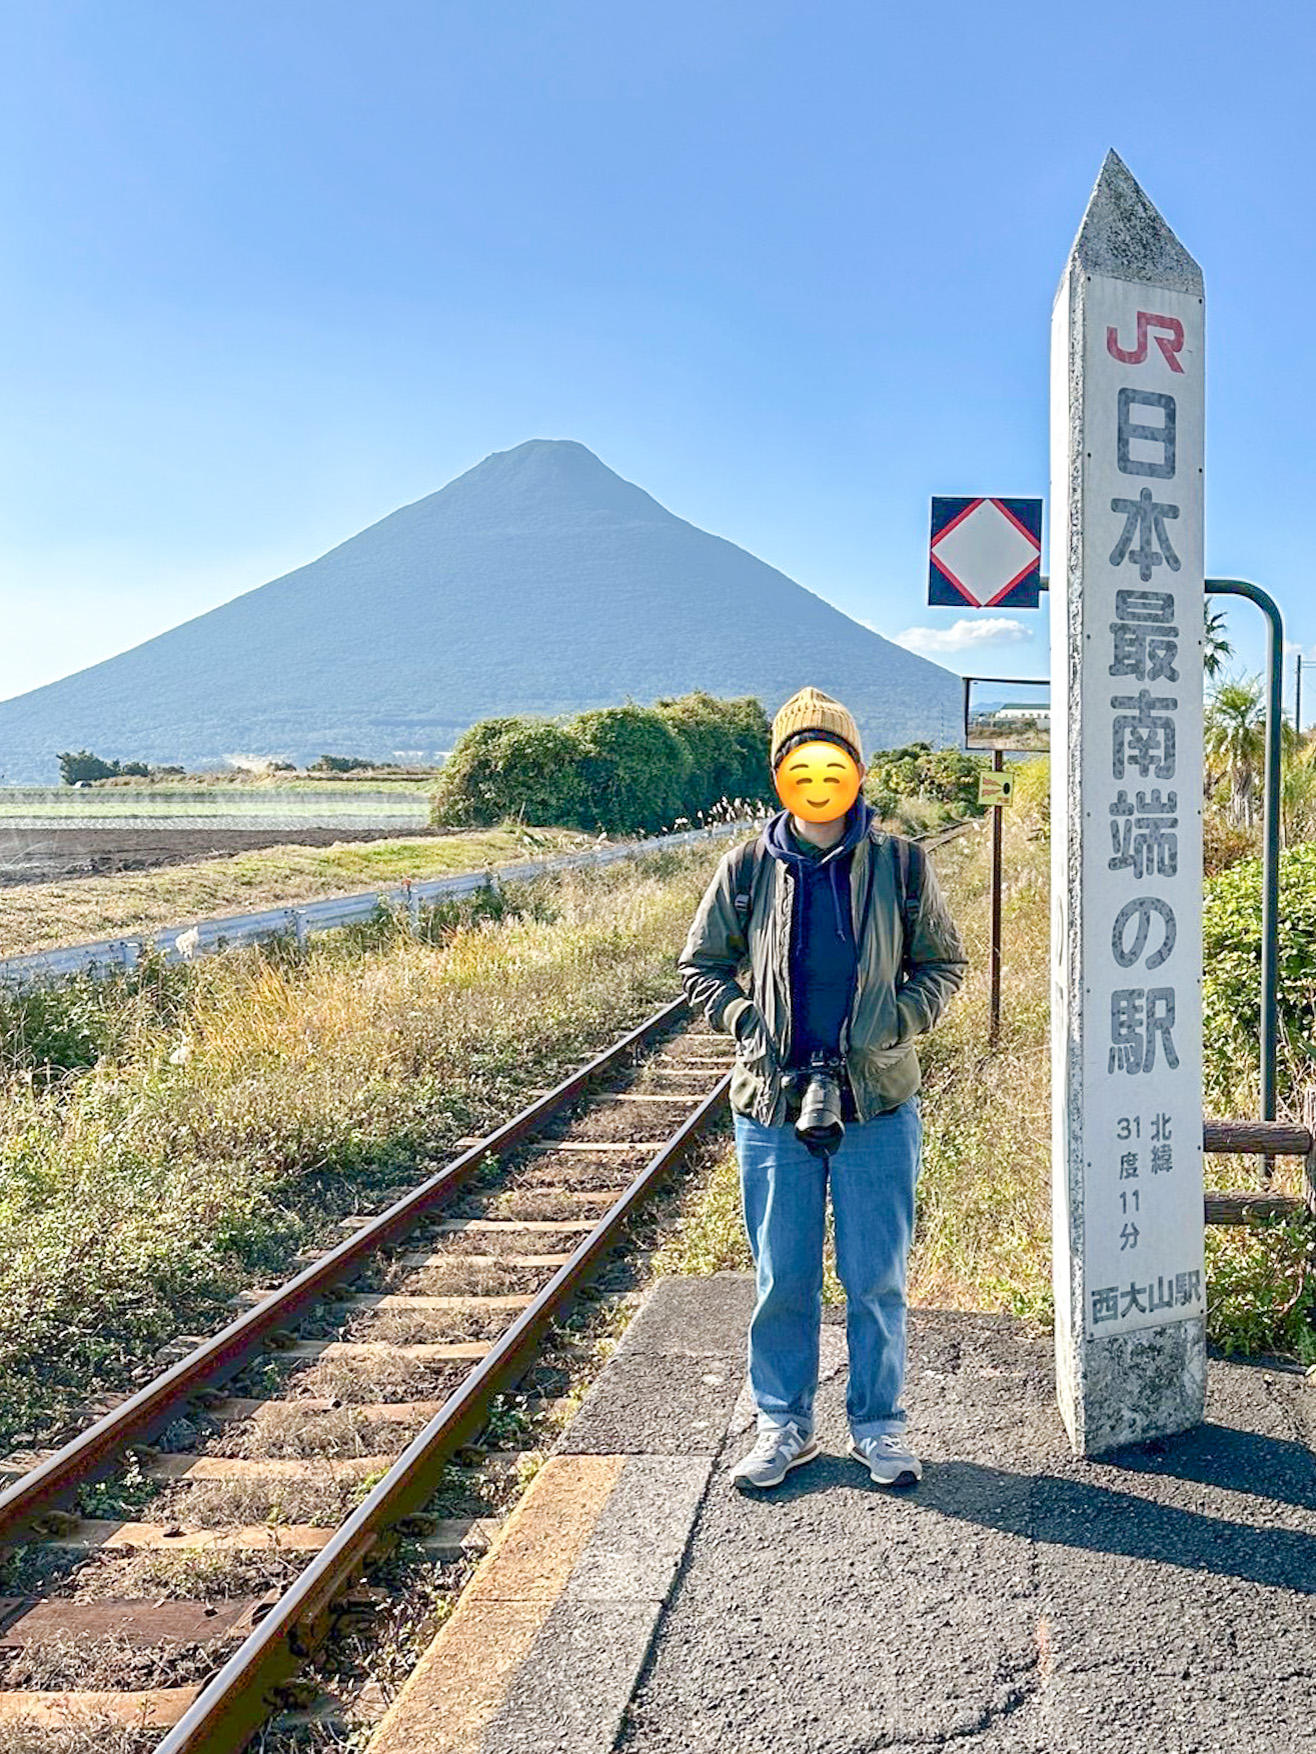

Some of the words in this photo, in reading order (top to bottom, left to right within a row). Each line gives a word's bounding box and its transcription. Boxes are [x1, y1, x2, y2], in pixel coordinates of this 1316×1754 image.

[1106, 310, 1185, 374] JR
[1108, 386, 1181, 1075] 日本最南端の駅
[1150, 1112, 1173, 1175] 北緯
[1091, 1269, 1201, 1325] 西大山駅
